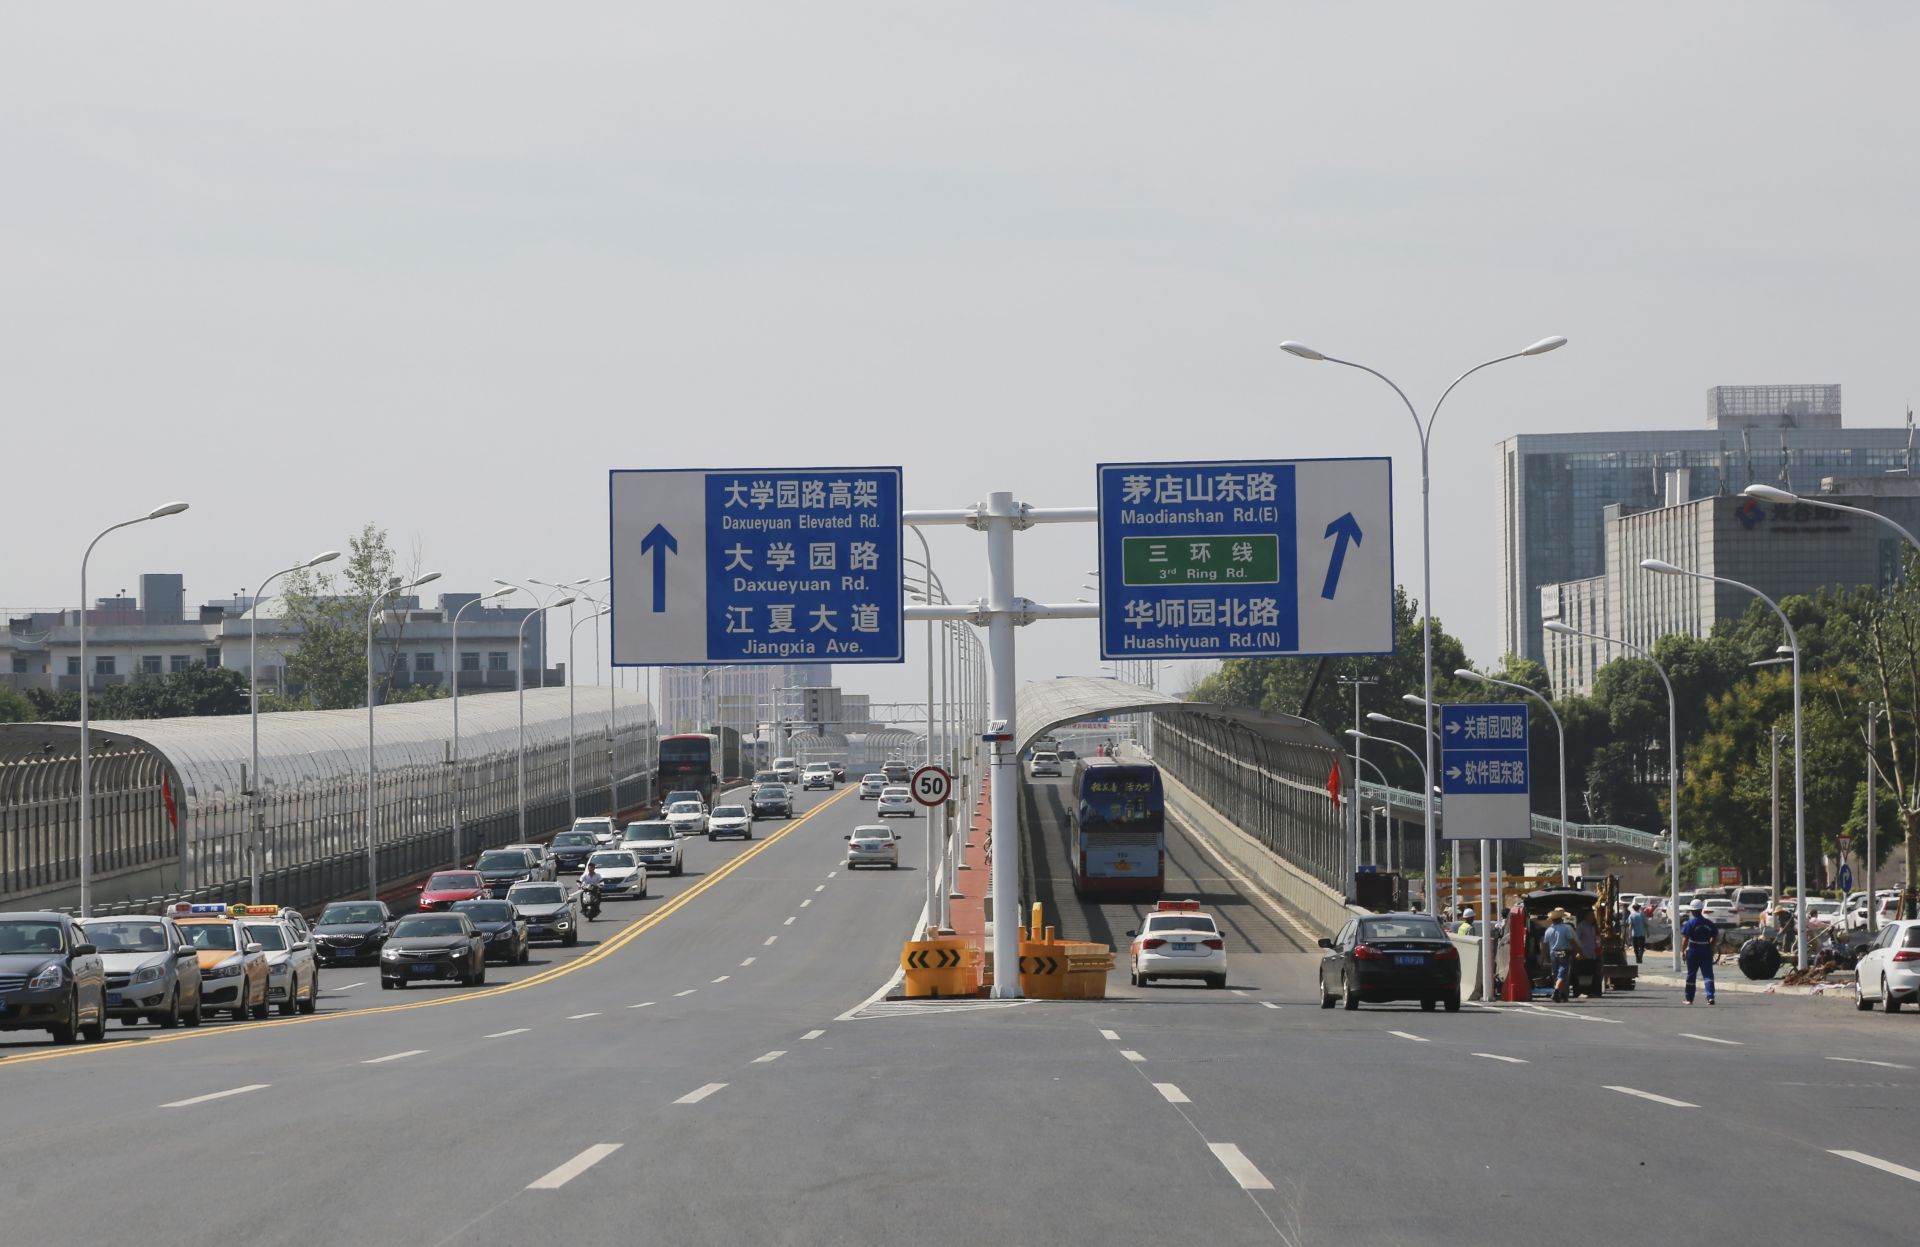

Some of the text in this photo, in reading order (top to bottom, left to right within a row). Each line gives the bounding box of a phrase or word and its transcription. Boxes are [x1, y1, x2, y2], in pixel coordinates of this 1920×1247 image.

[724, 479, 878, 510] 大学园路高架
[1122, 472, 1278, 504] 茅店山东路
[723, 514, 880, 532] Daxueyuan Elevated Rd.
[1121, 507, 1278, 524] Maodianshan Rd.(E)
[724, 541, 879, 572] 大学园路
[1149, 542, 1253, 563] 三环线
[1159, 568, 1247, 580] 3rd Ring Rd.
[734, 576, 869, 594] Daxueyuan Rd.
[725, 603, 880, 634] 江夏大道
[1124, 598, 1280, 629] 华师园北路
[742, 638, 863, 657] Jiangxia Ave.
[1124, 632, 1280, 651] Huashiyuan Rd.(N)
[1464, 715, 1524, 739] 关南园四路
[1464, 760, 1525, 785] 软件园东路
[921, 777, 943, 795] 50
